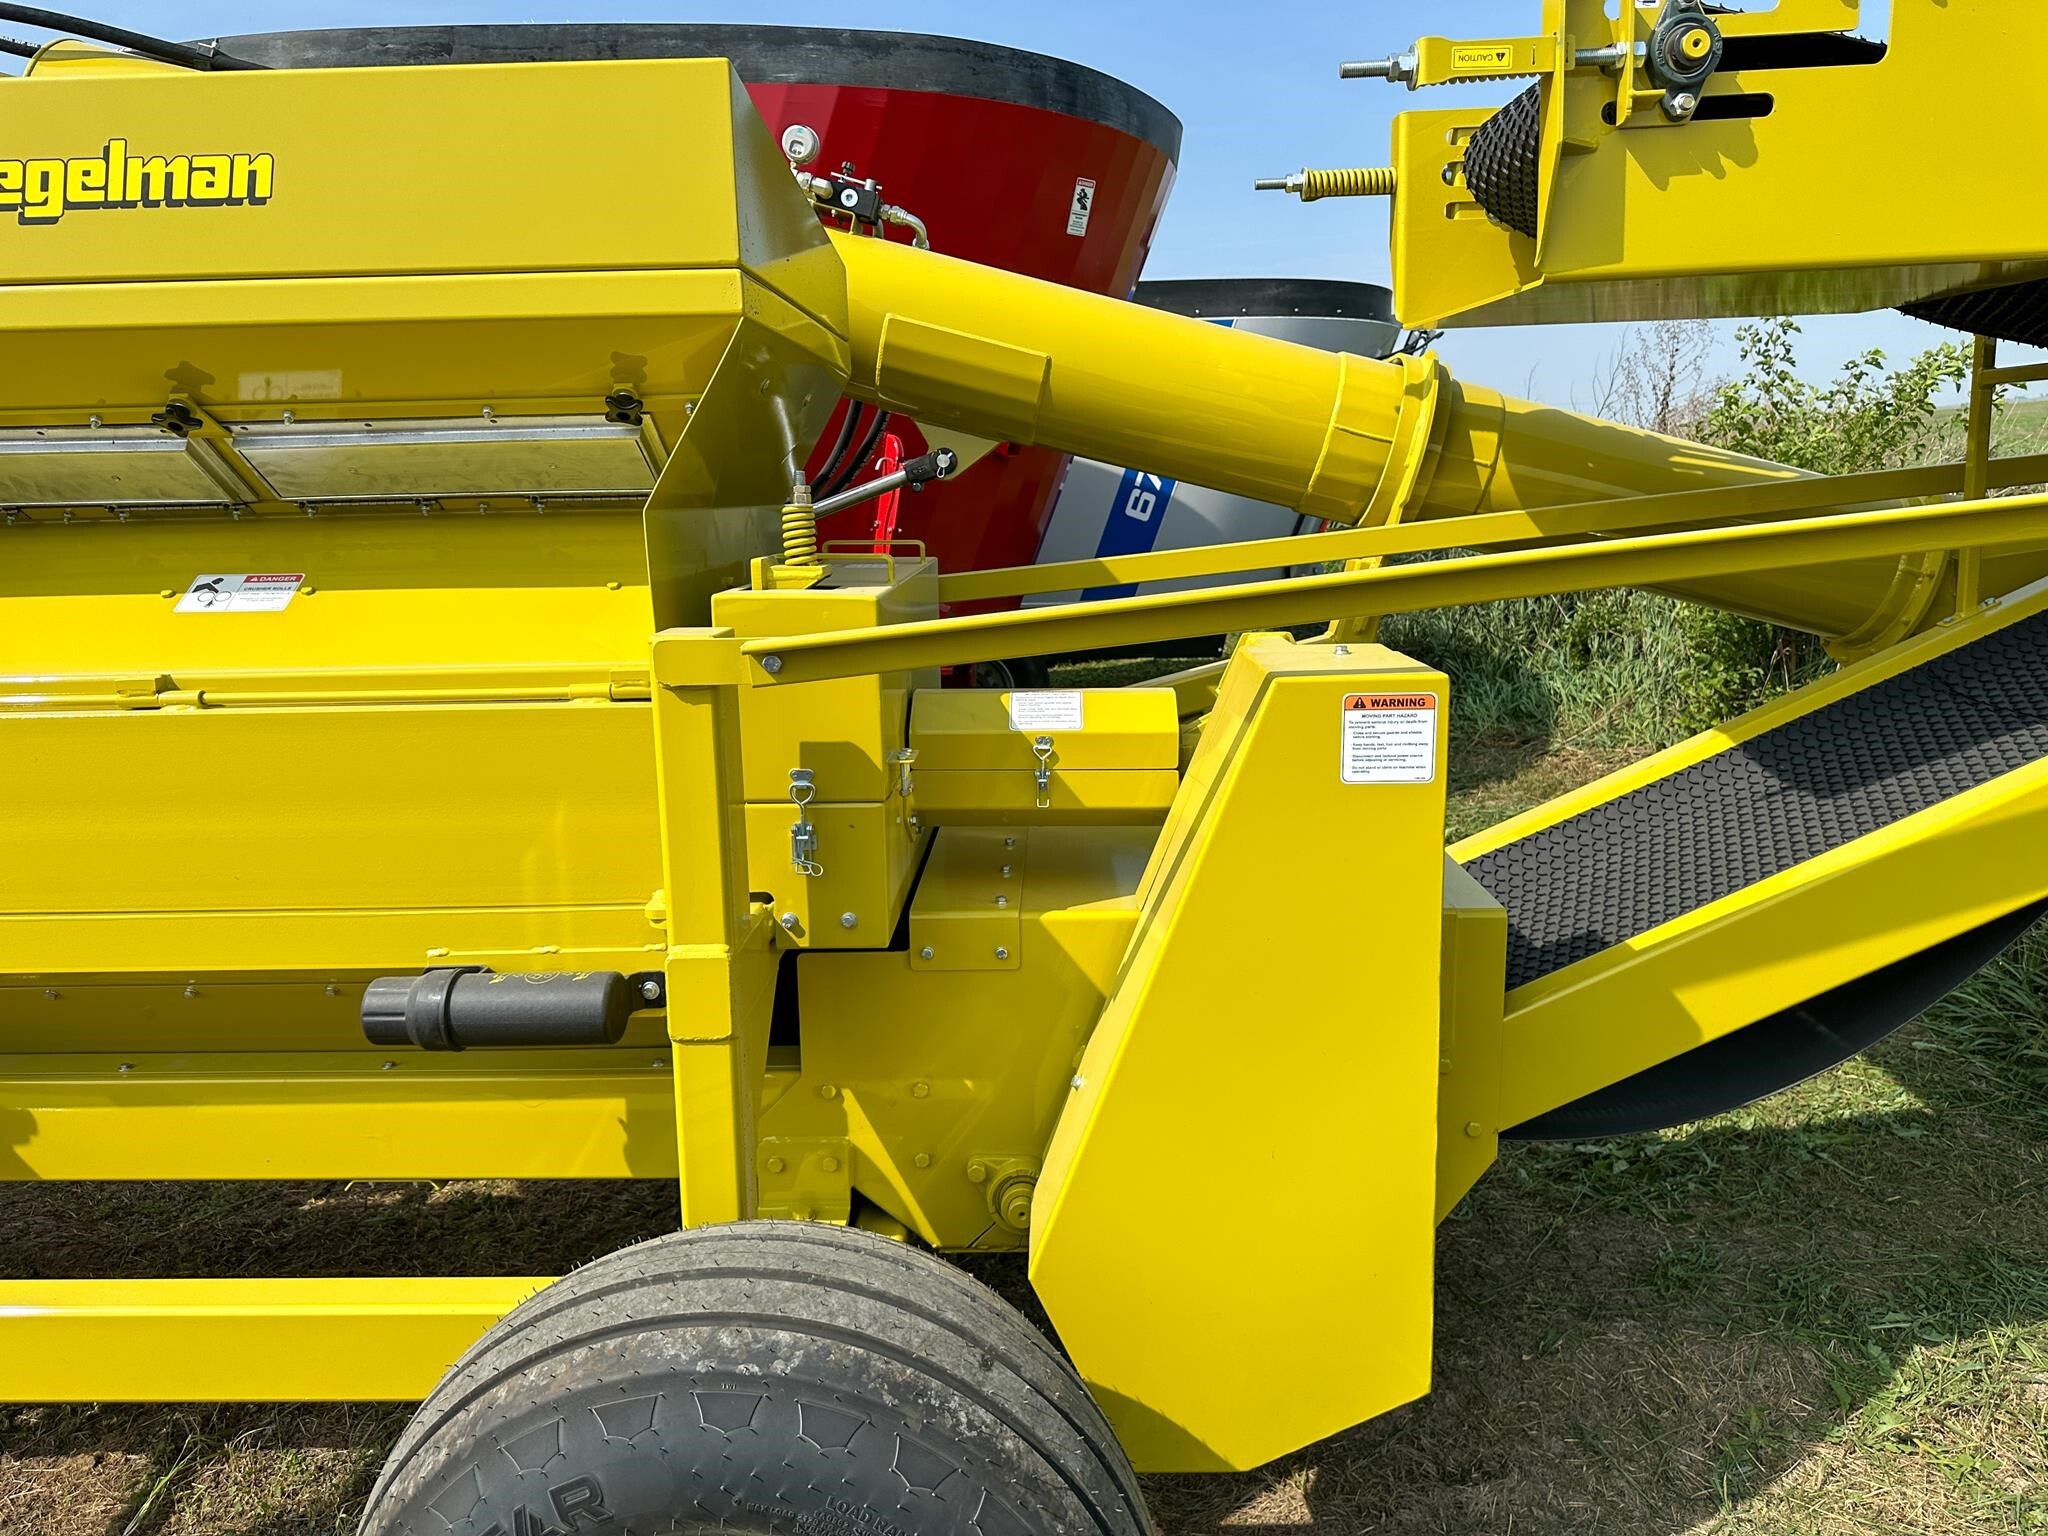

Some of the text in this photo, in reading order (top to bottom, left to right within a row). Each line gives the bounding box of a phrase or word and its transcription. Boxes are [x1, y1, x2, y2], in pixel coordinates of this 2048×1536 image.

[1458, 54, 1493, 62] CAUTION
[1370, 698, 1426, 708] WARNING
[825, 1495, 874, 1524] LOAD
